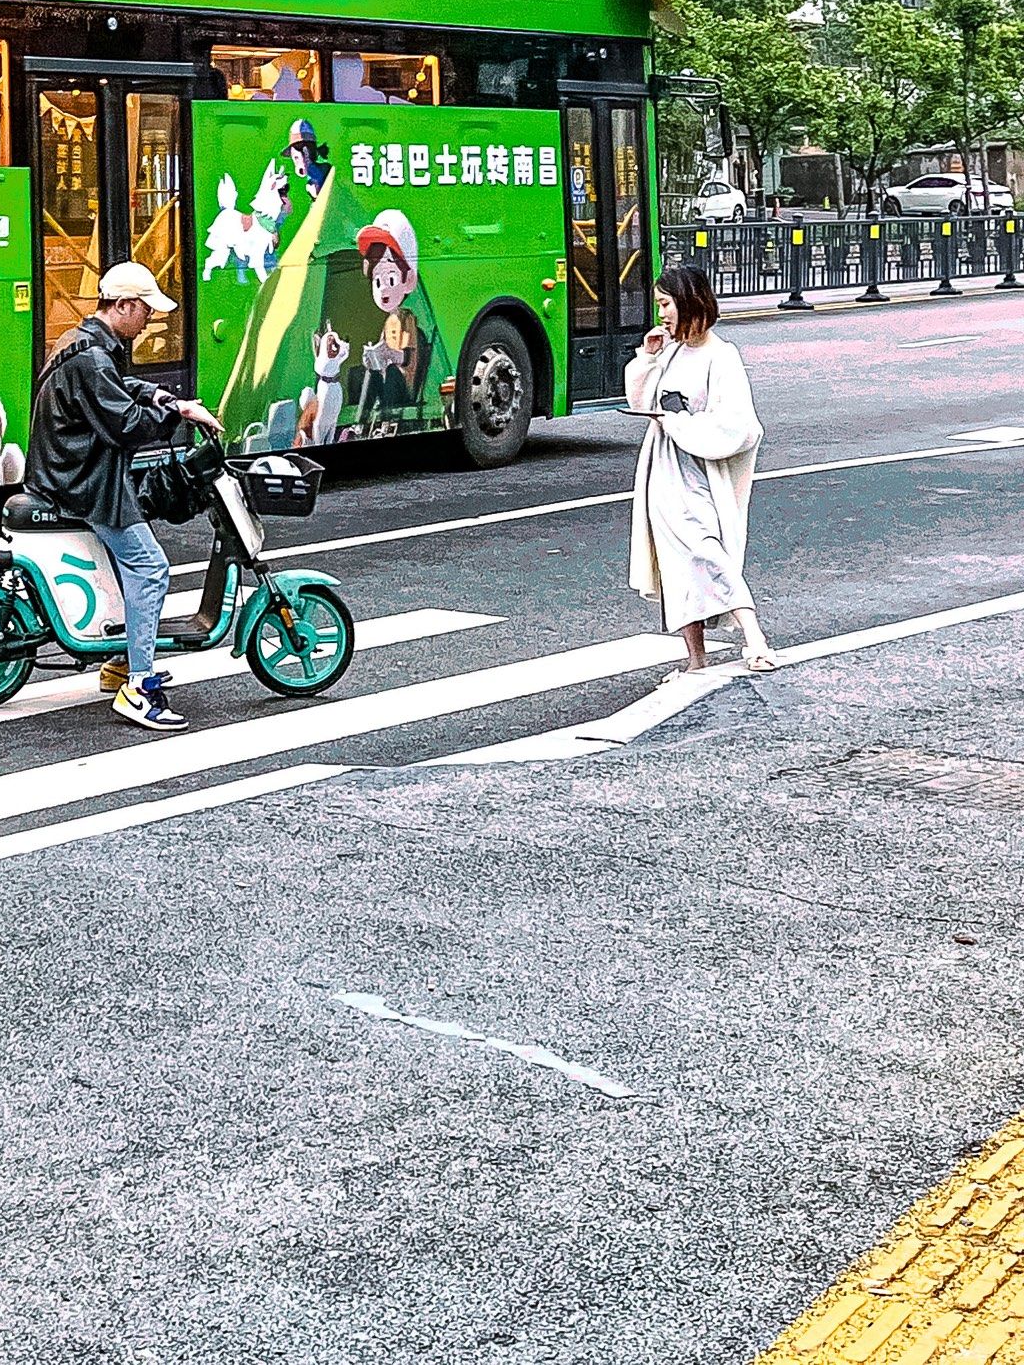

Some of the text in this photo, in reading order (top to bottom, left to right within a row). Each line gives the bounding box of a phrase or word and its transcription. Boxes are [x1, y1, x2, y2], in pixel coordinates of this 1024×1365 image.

[350, 143, 558, 187] 奇遇巴士玩转南昌
